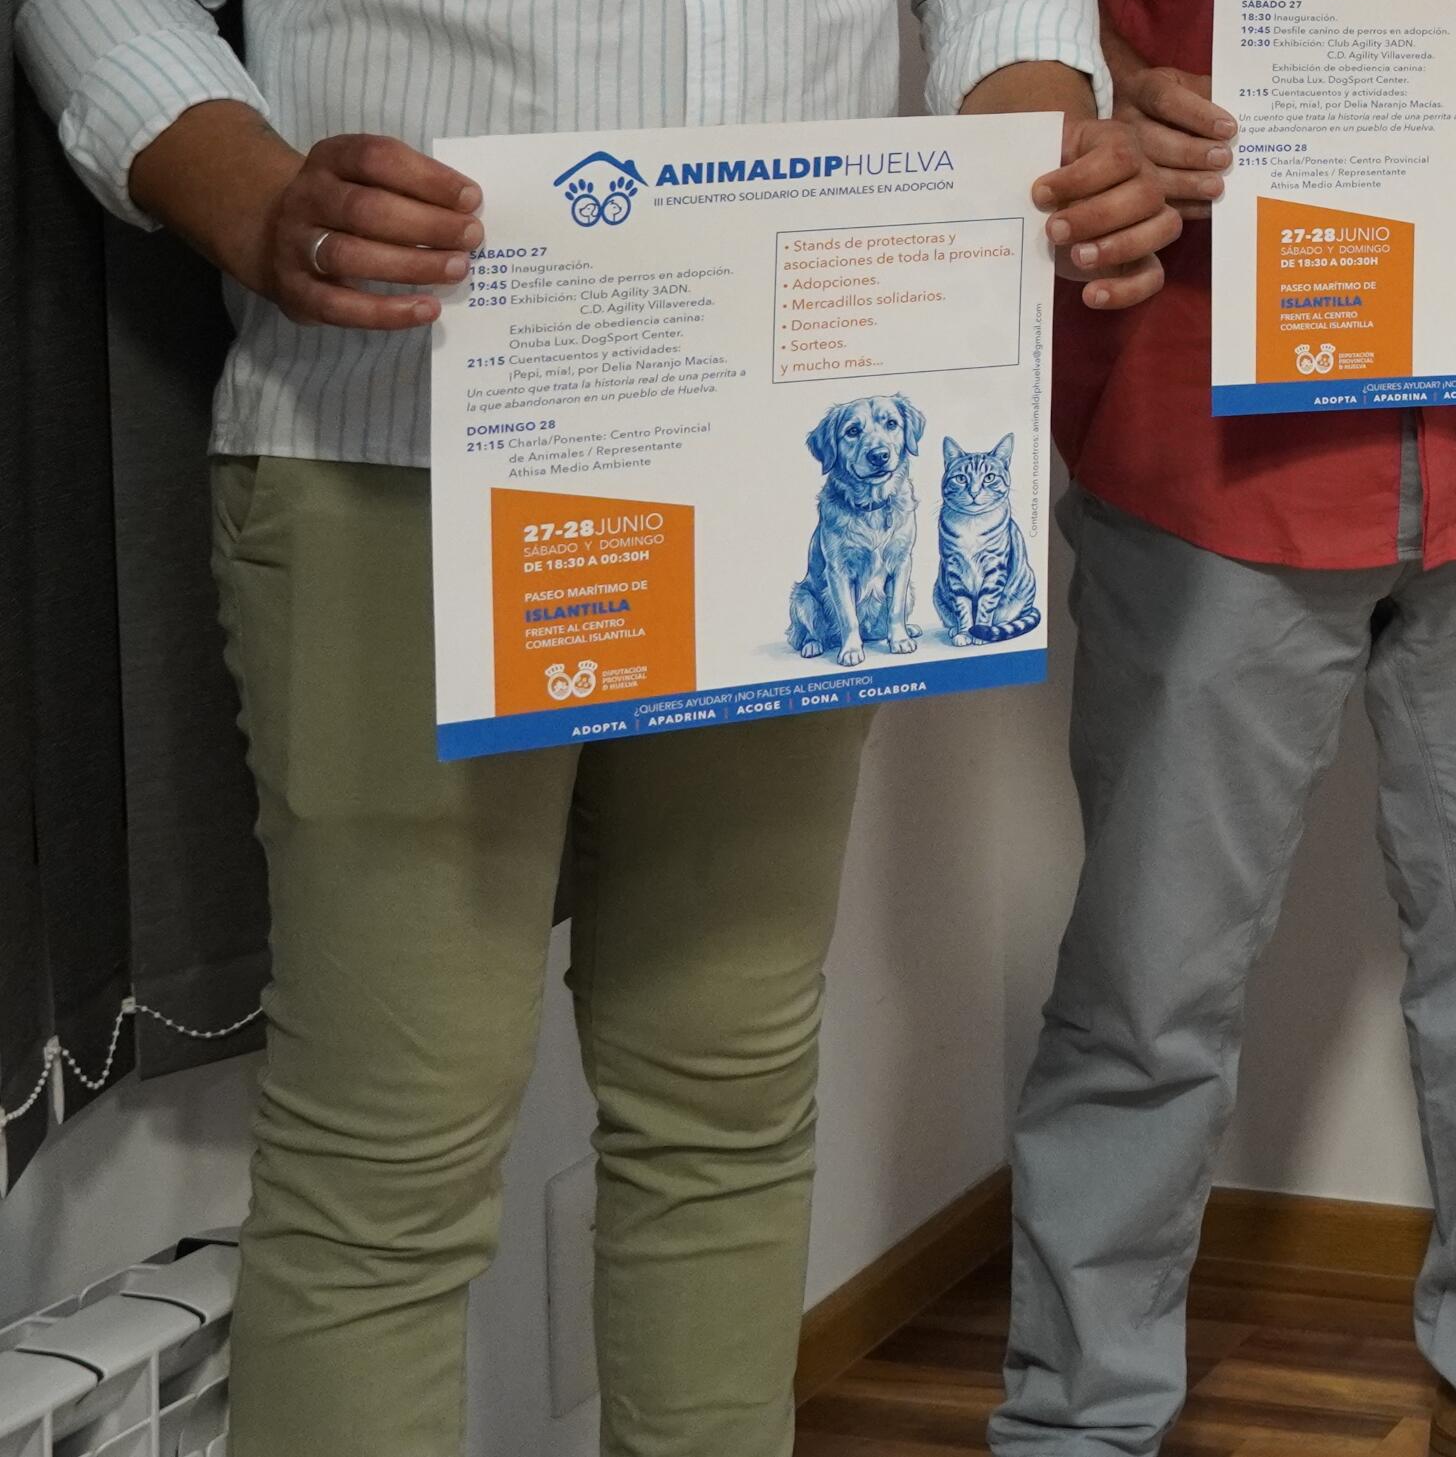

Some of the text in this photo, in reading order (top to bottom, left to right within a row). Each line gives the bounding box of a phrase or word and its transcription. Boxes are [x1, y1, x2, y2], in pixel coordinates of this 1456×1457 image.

[1288, 0, 1302, 8] 27
[1241, 12, 1271, 21] 18:30
[1238, 143, 1307, 153] DOMINGO 28
[655, 150, 953, 186] ANIMALDIPHUELVA
[469, 246, 547, 260] SÁBADO 27
[469, 263, 508, 275] 18:30
[468, 279, 507, 291] 19:45
[510, 277, 552, 290] Desfile
[555, 275, 596, 287] canino
[598, 274, 614, 284] de
[617, 273, 655, 285] perros
[791, 275, 879, 291] Adopciones.
[1280, 280, 1376, 292] PASEO MARÍTIMO DE
[791, 290, 945, 311] Mercadillos solidarios.
[1280, 294, 1363, 309] ISLANTILLA
[790, 316, 877, 331] Donaciones.
[1313, 395, 1357, 404] ADOPTA
[1373, 392, 1427, 402] APADRINA
[466, 419, 556, 436] DOMINGO 28
[523, 549, 649, 573] DE 18:30 A 00:30H
[524, 598, 631, 623] ISLANTILLA
[571, 681, 927, 736] ADOPTA APADRINA ACOGE DONA COLABORA
